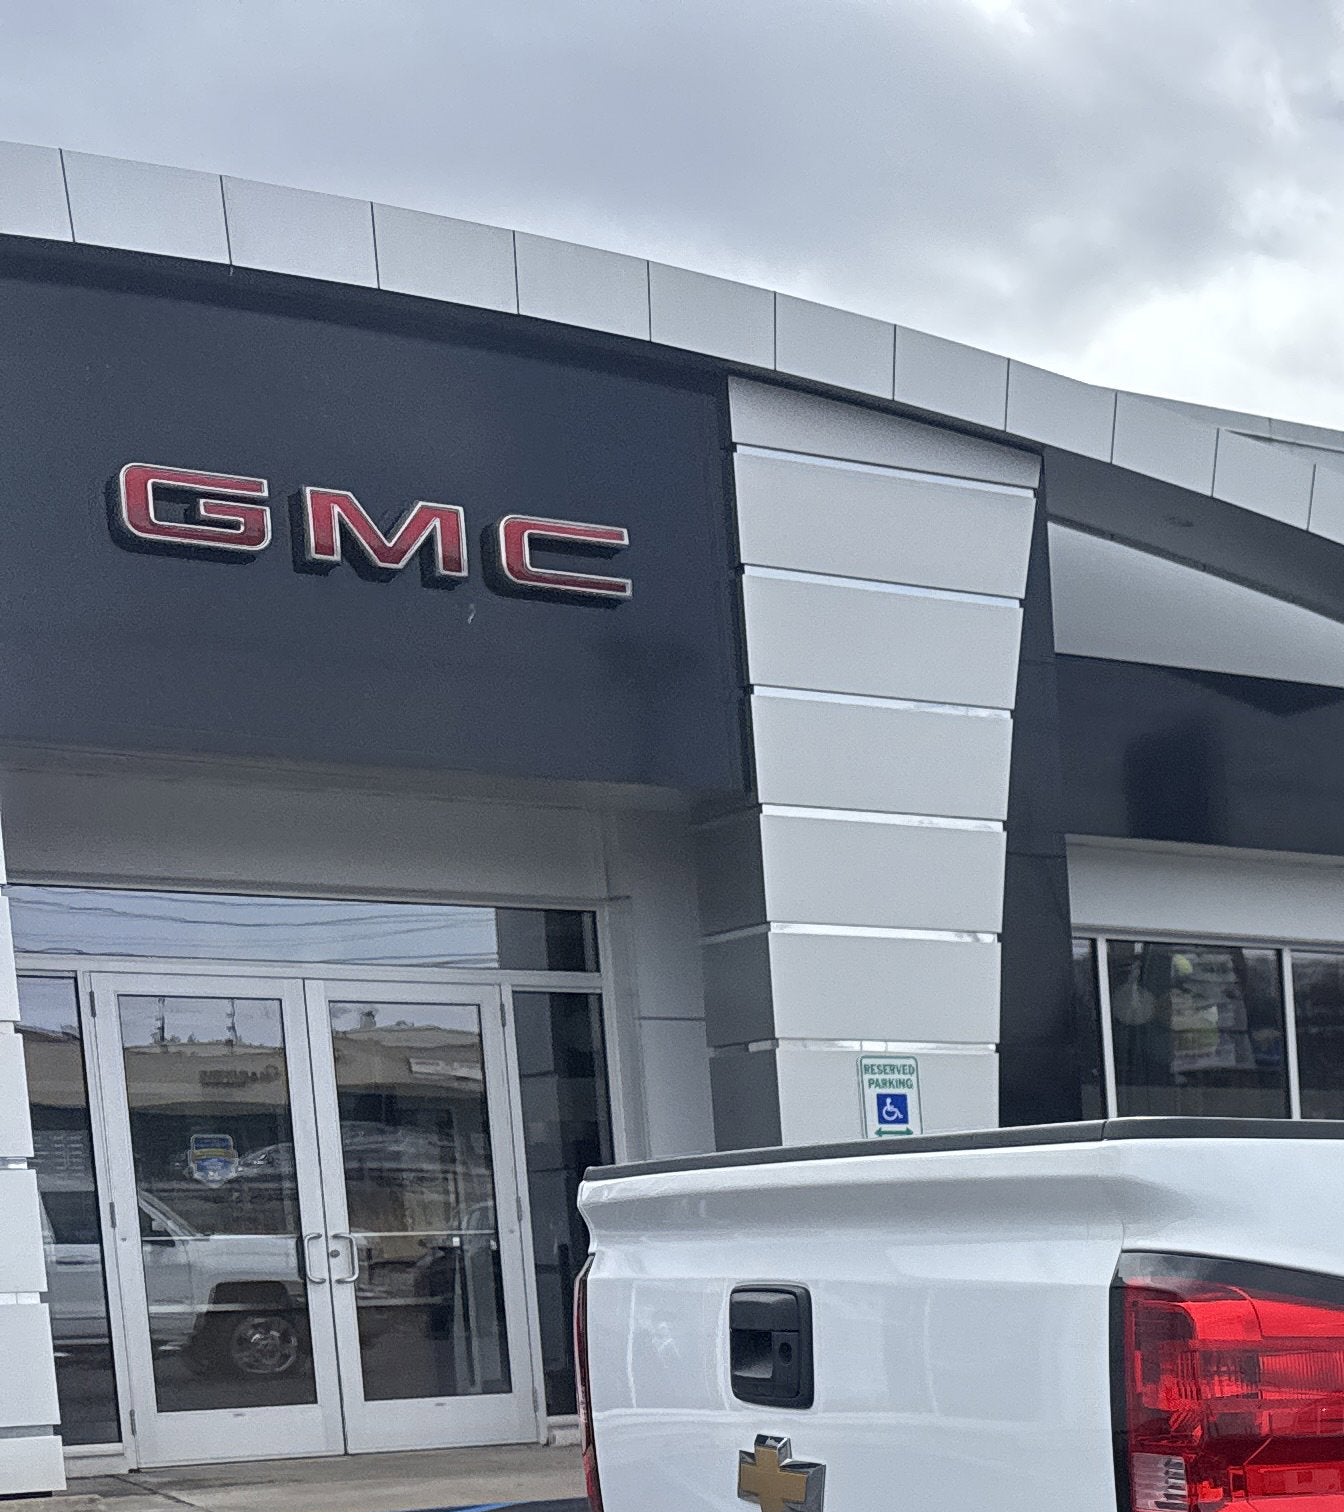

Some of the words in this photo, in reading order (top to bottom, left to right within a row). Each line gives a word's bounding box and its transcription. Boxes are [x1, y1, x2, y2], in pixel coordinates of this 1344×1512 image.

[118, 462, 633, 599] GMC
[863, 1063, 915, 1076] RESERVED
[868, 1077, 914, 1090] PARKING
